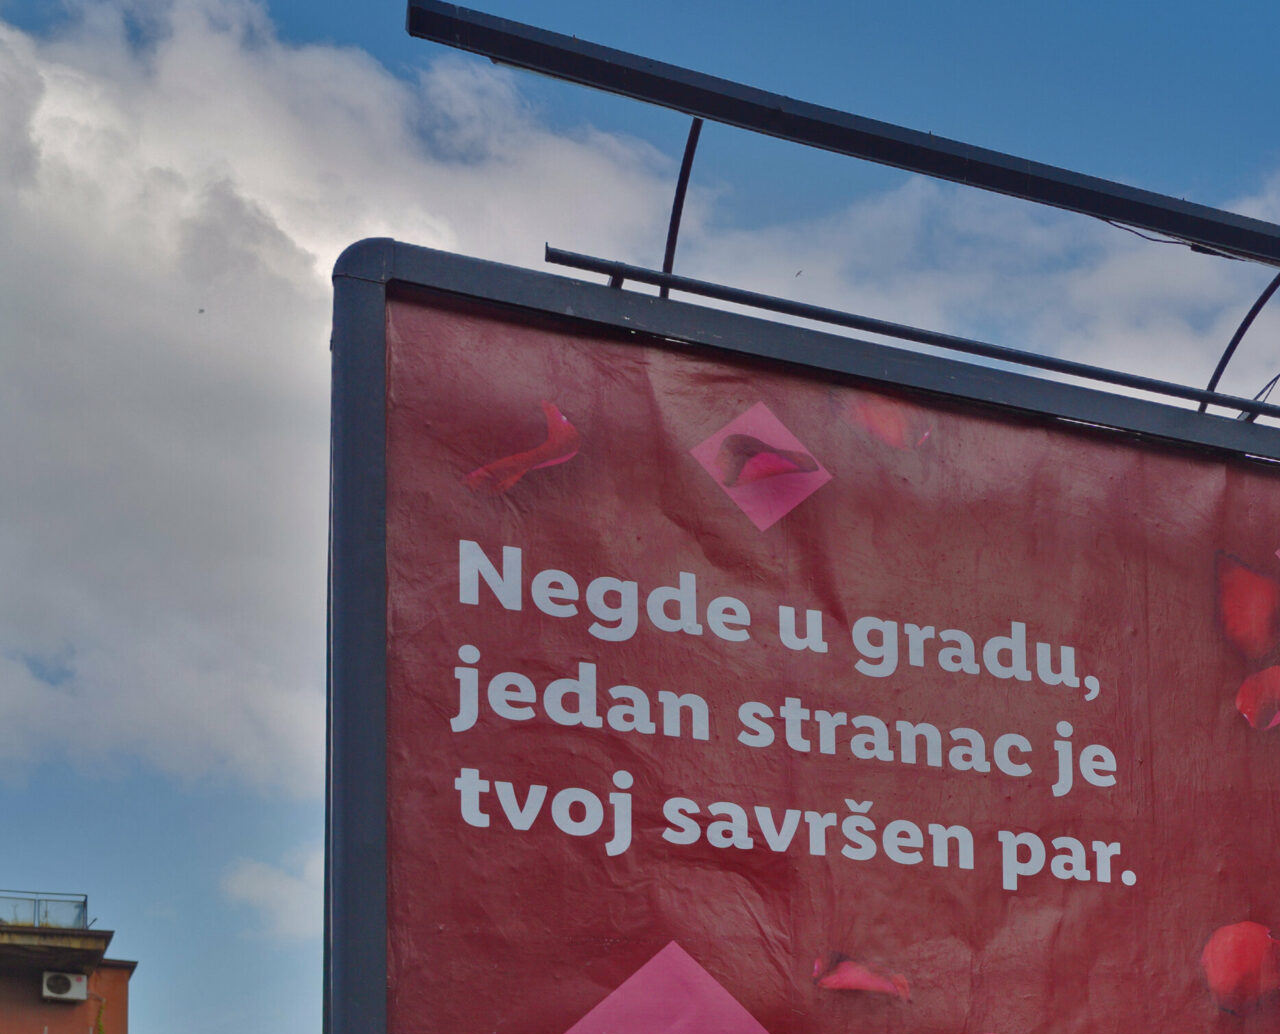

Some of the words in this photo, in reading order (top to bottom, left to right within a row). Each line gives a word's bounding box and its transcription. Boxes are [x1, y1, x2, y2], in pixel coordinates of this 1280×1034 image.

[459, 539, 751, 642] Negde
[778, 605, 828, 653] u
[852, 616, 1100, 701] gradu,
[449, 645, 710, 741] jedan
[737, 697, 1033, 777] stranac
[1052, 721, 1117, 797] je
[454, 767, 634, 857] tvoj
[662, 798, 974, 870] savršen
[998, 827, 1137, 891] par.
